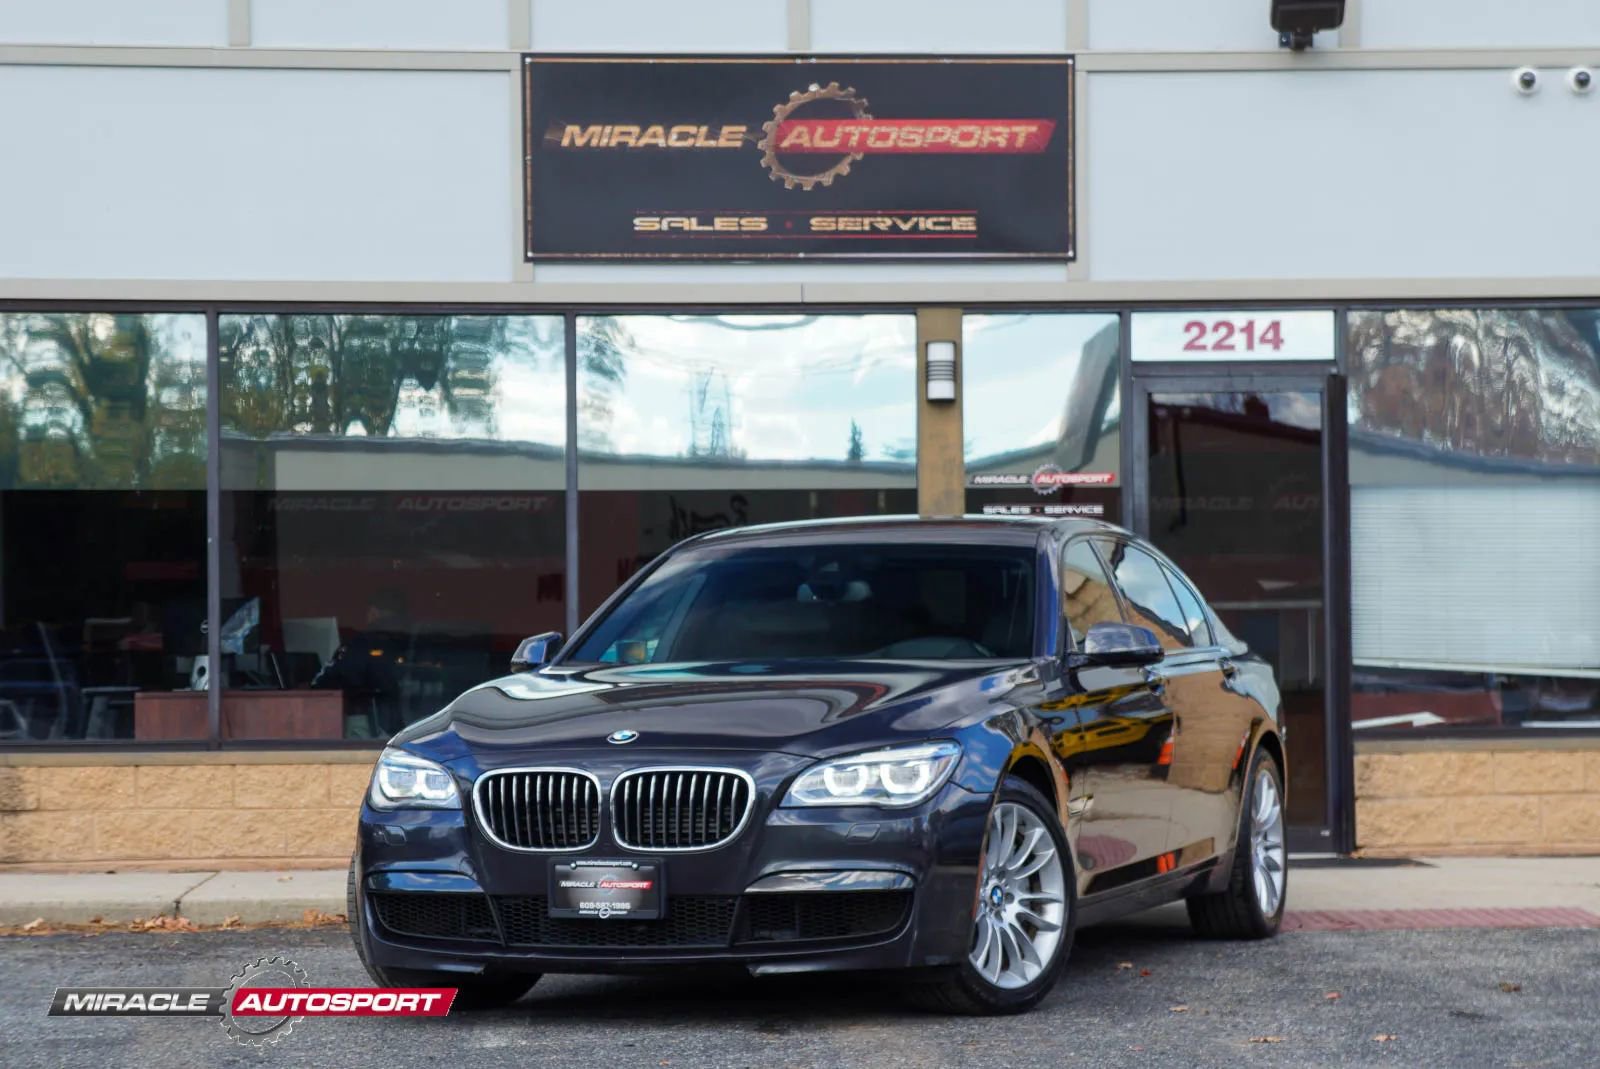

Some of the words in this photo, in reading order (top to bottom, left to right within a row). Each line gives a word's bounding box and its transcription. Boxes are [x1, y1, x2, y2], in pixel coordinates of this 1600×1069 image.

[560, 124, 747, 148] MIRACLE
[780, 124, 1039, 148] AUTOSPORT
[633, 216, 769, 231] SALES
[809, 216, 977, 231] SERVICE
[1183, 320, 1284, 351] 2214
[974, 475, 1028, 484] MIRACLE
[1037, 473, 1112, 484] AUTOSPORT
[267, 497, 378, 511] MIRACLE
[397, 497, 548, 511] AUTOSPORT
[983, 505, 1031, 514] SALES
[1044, 505, 1104, 514] SERVICE
